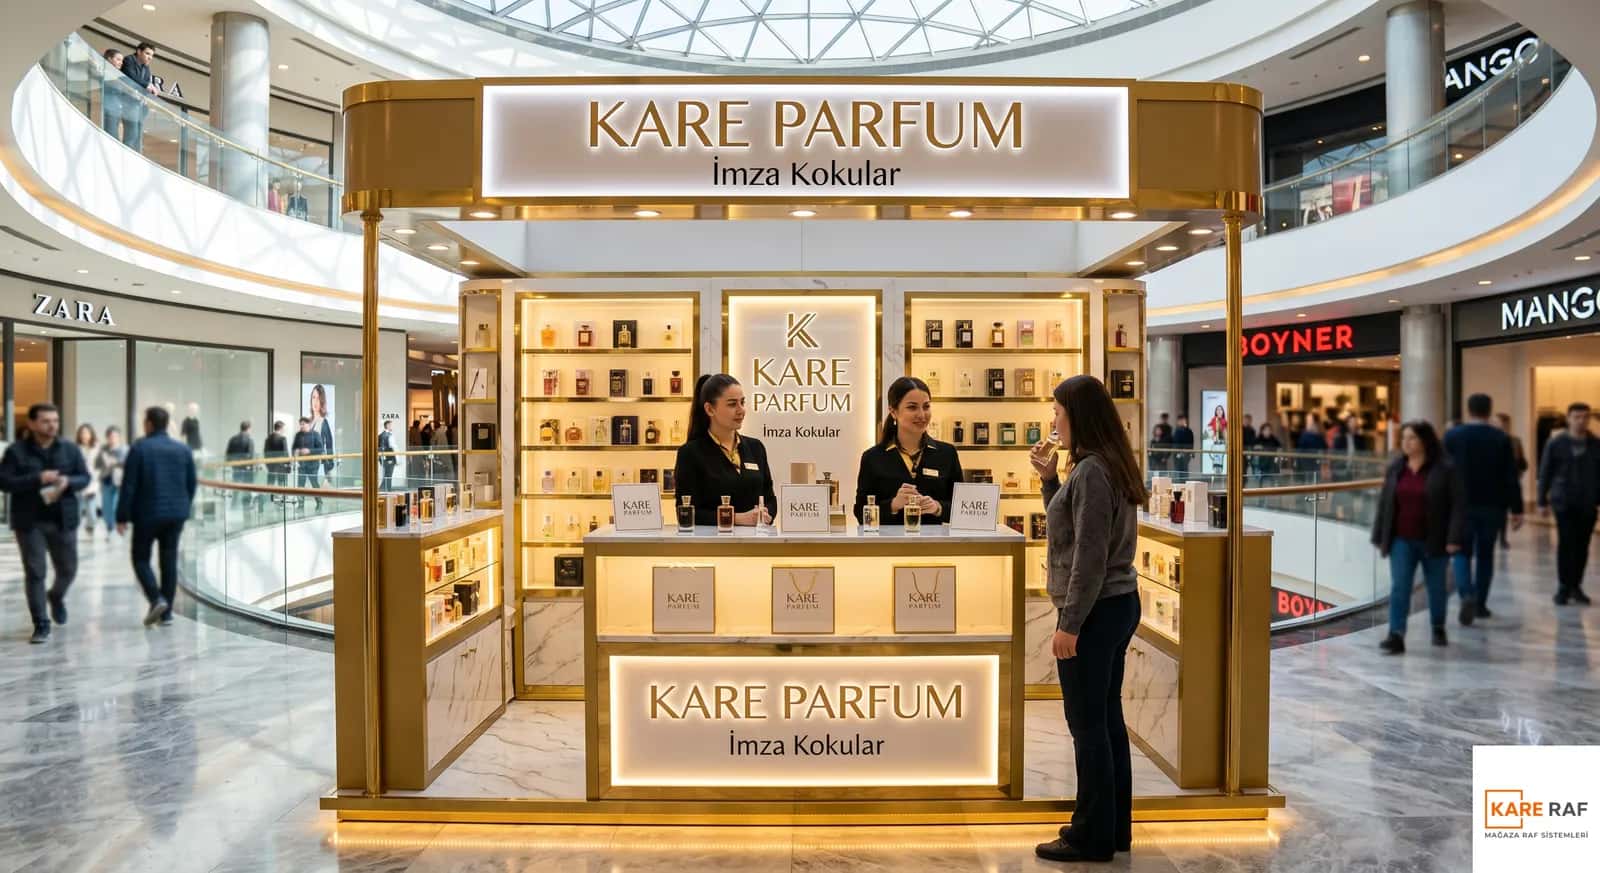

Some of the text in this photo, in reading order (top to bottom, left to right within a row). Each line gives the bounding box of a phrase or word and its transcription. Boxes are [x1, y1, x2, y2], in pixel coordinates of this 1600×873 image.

[1445, 37, 1539, 90] ANGO
[150, 75, 184, 98] RA
[588, 100, 1022, 150] KARE PARFUM
[712, 155, 902, 187] İmza Kokular
[32, 293, 116, 326] ZARA
[1501, 286, 1600, 331] MANG
[753, 358, 851, 386] KARE
[753, 393, 851, 412] PARFUM
[763, 424, 841, 438] İmza Kokular
[622, 500, 651, 510] KARE
[790, 502, 819, 511] KARE
[960, 500, 989, 510] KARE
[667, 592, 700, 603] KARE
[786, 592, 820, 603] KARE
[908, 592, 941, 603] KARE
[650, 684, 962, 720] KARE PARFUM
[729, 729, 885, 756] İmza Kokular
